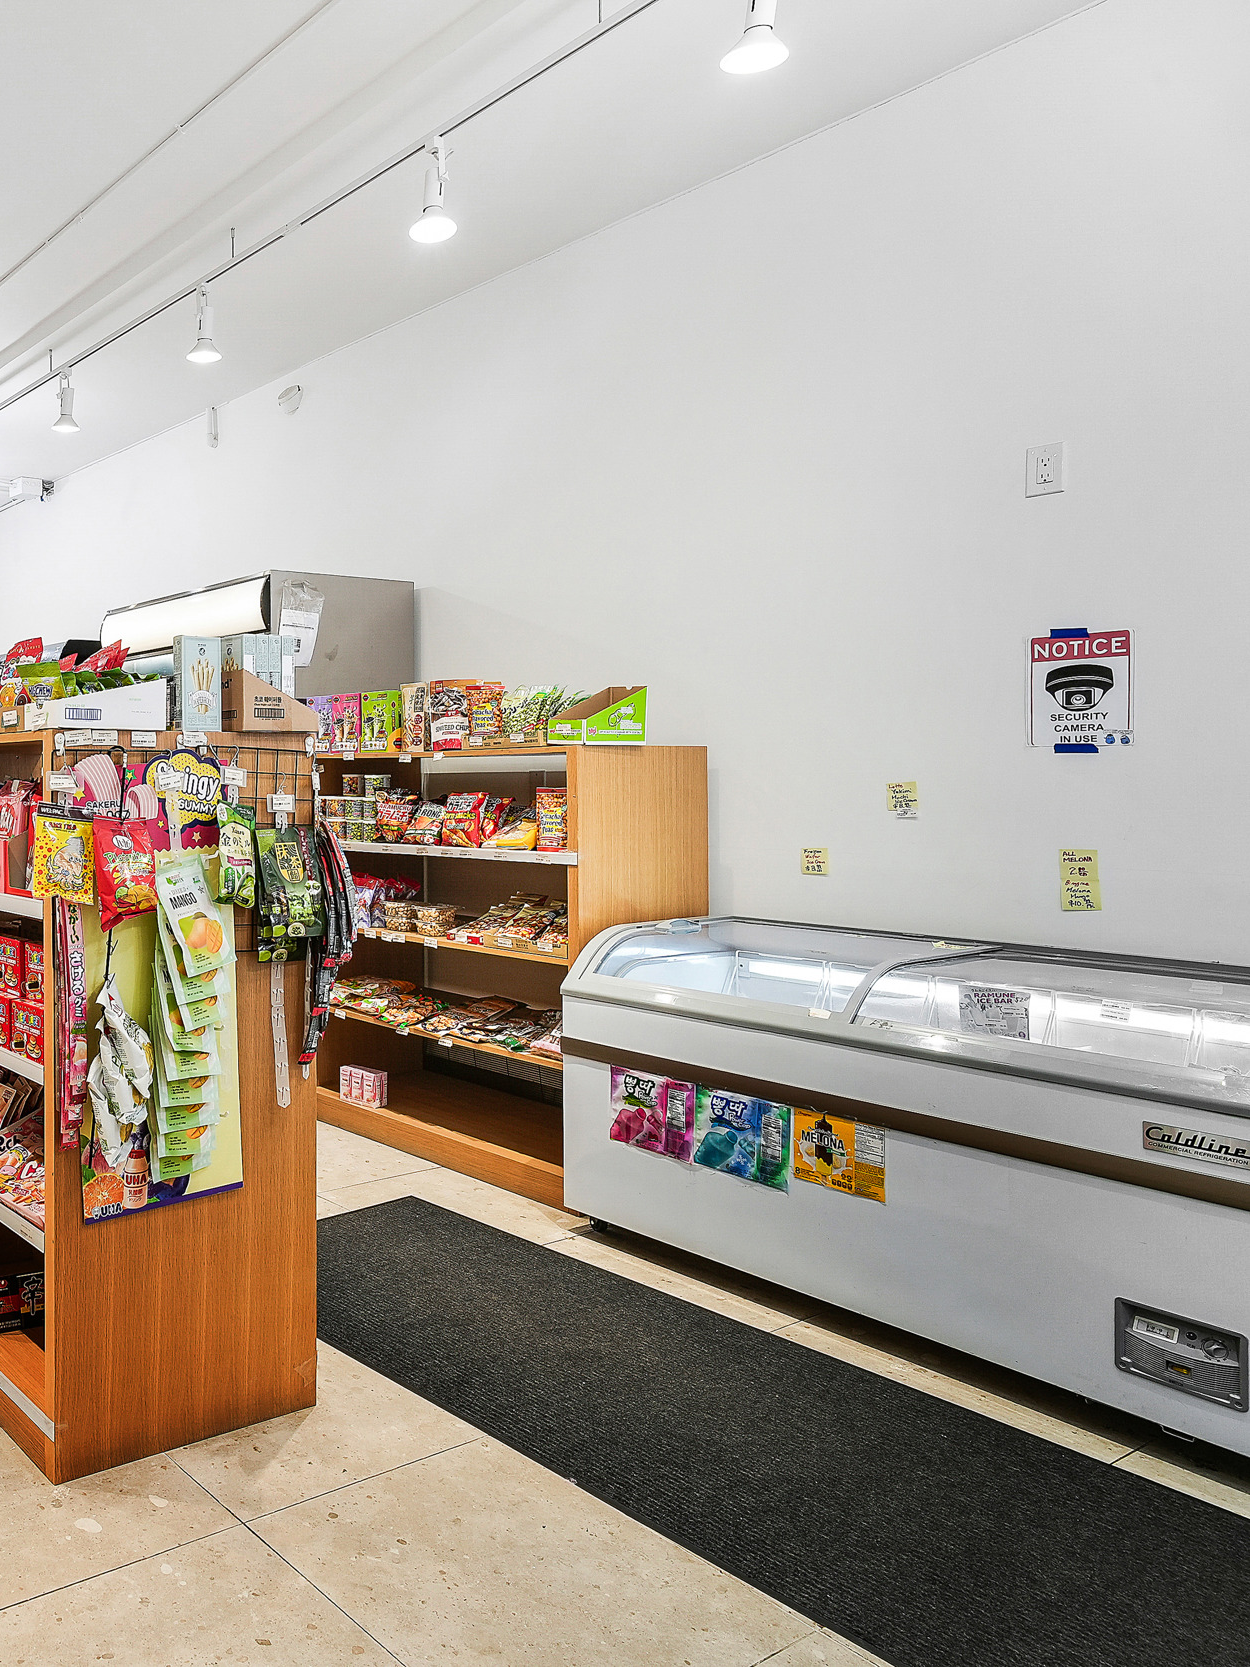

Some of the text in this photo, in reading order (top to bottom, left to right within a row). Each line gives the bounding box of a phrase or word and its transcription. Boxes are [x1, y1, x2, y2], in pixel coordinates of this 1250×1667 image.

[1033, 636, 1127, 659] NOTICE
[1050, 712, 1109, 722] SECURITY
[1054, 724, 1104, 732] CAMERA
[1060, 734, 1098, 743] IN USE
[169, 892, 198, 910] MANGO
[801, 1129, 846, 1152] MELONA
[1145, 1126, 1250, 1160] Coldline
[1148, 1141, 1249, 1166] COMMERCIAL REFRIGERATION
[795, 1166, 801, 1175] 8
[125, 1174, 147, 1186] UHA
